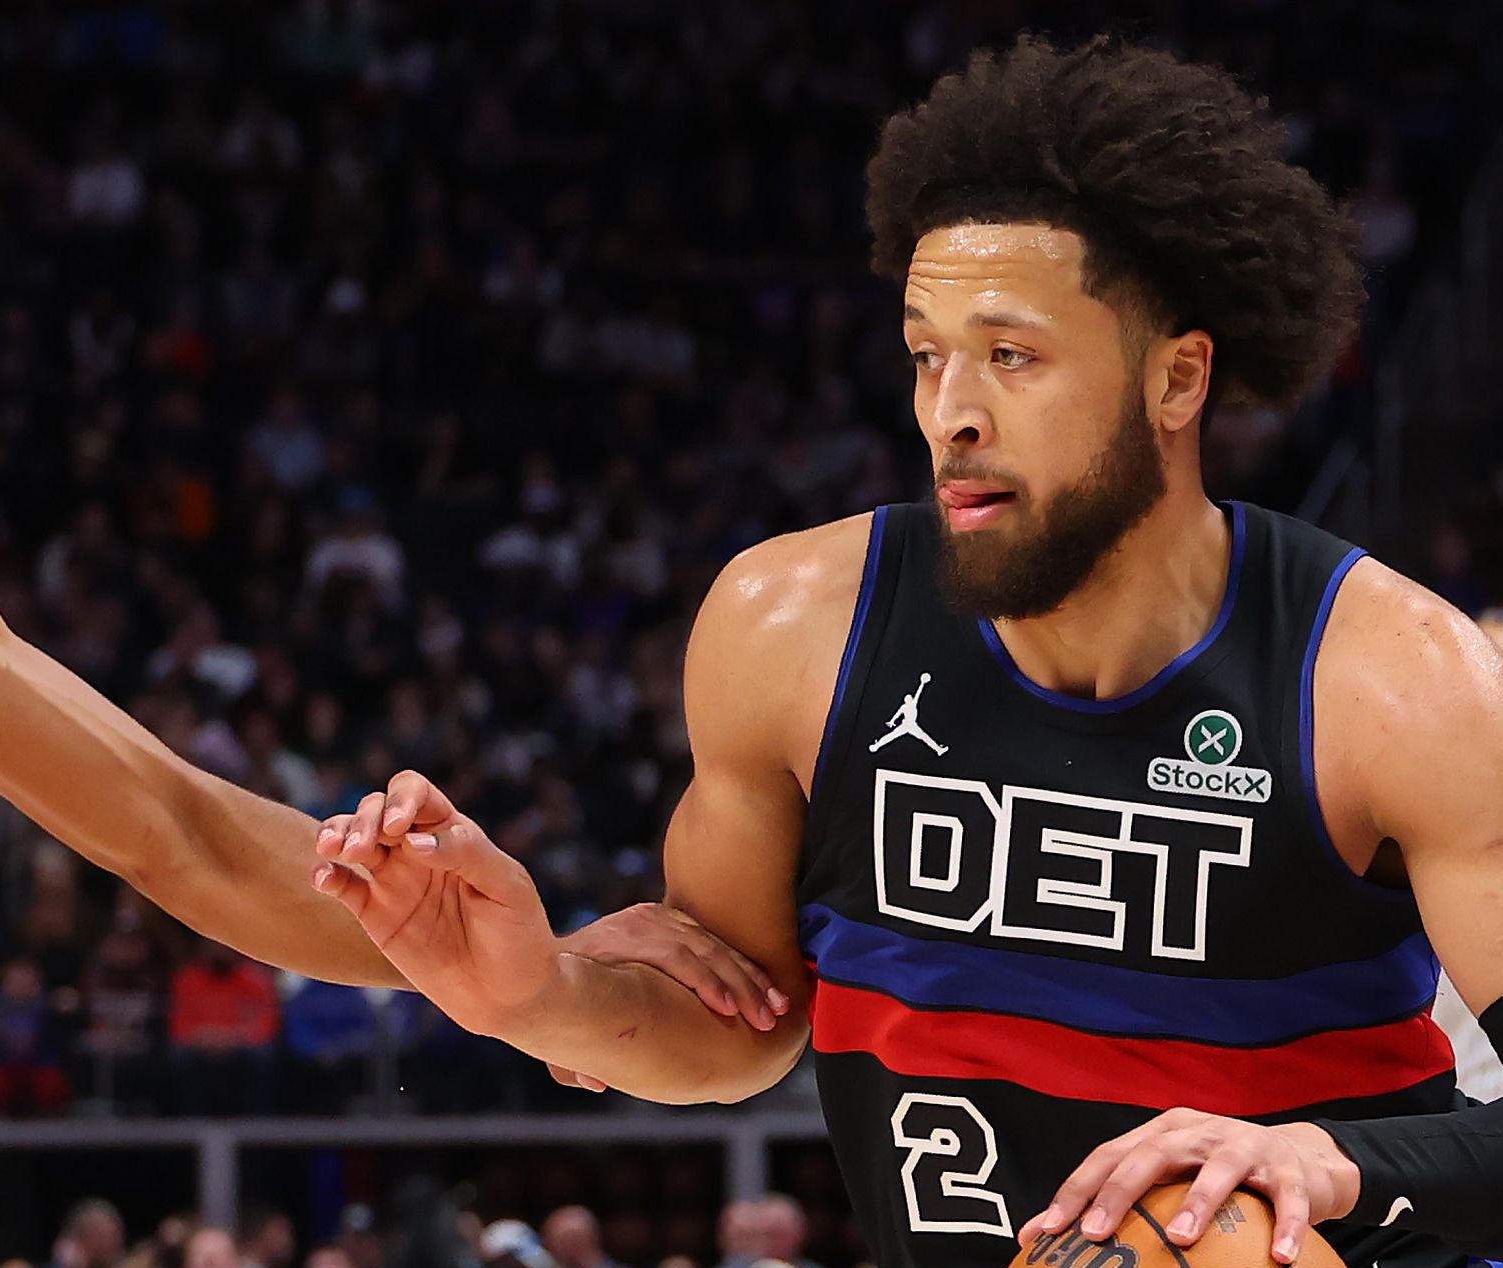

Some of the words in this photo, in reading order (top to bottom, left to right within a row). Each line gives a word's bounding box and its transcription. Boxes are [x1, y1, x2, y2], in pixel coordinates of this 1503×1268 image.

[1152, 762, 1267, 800] StockX
[873, 767, 1254, 962] DET
[890, 1091, 1013, 1239] 2
